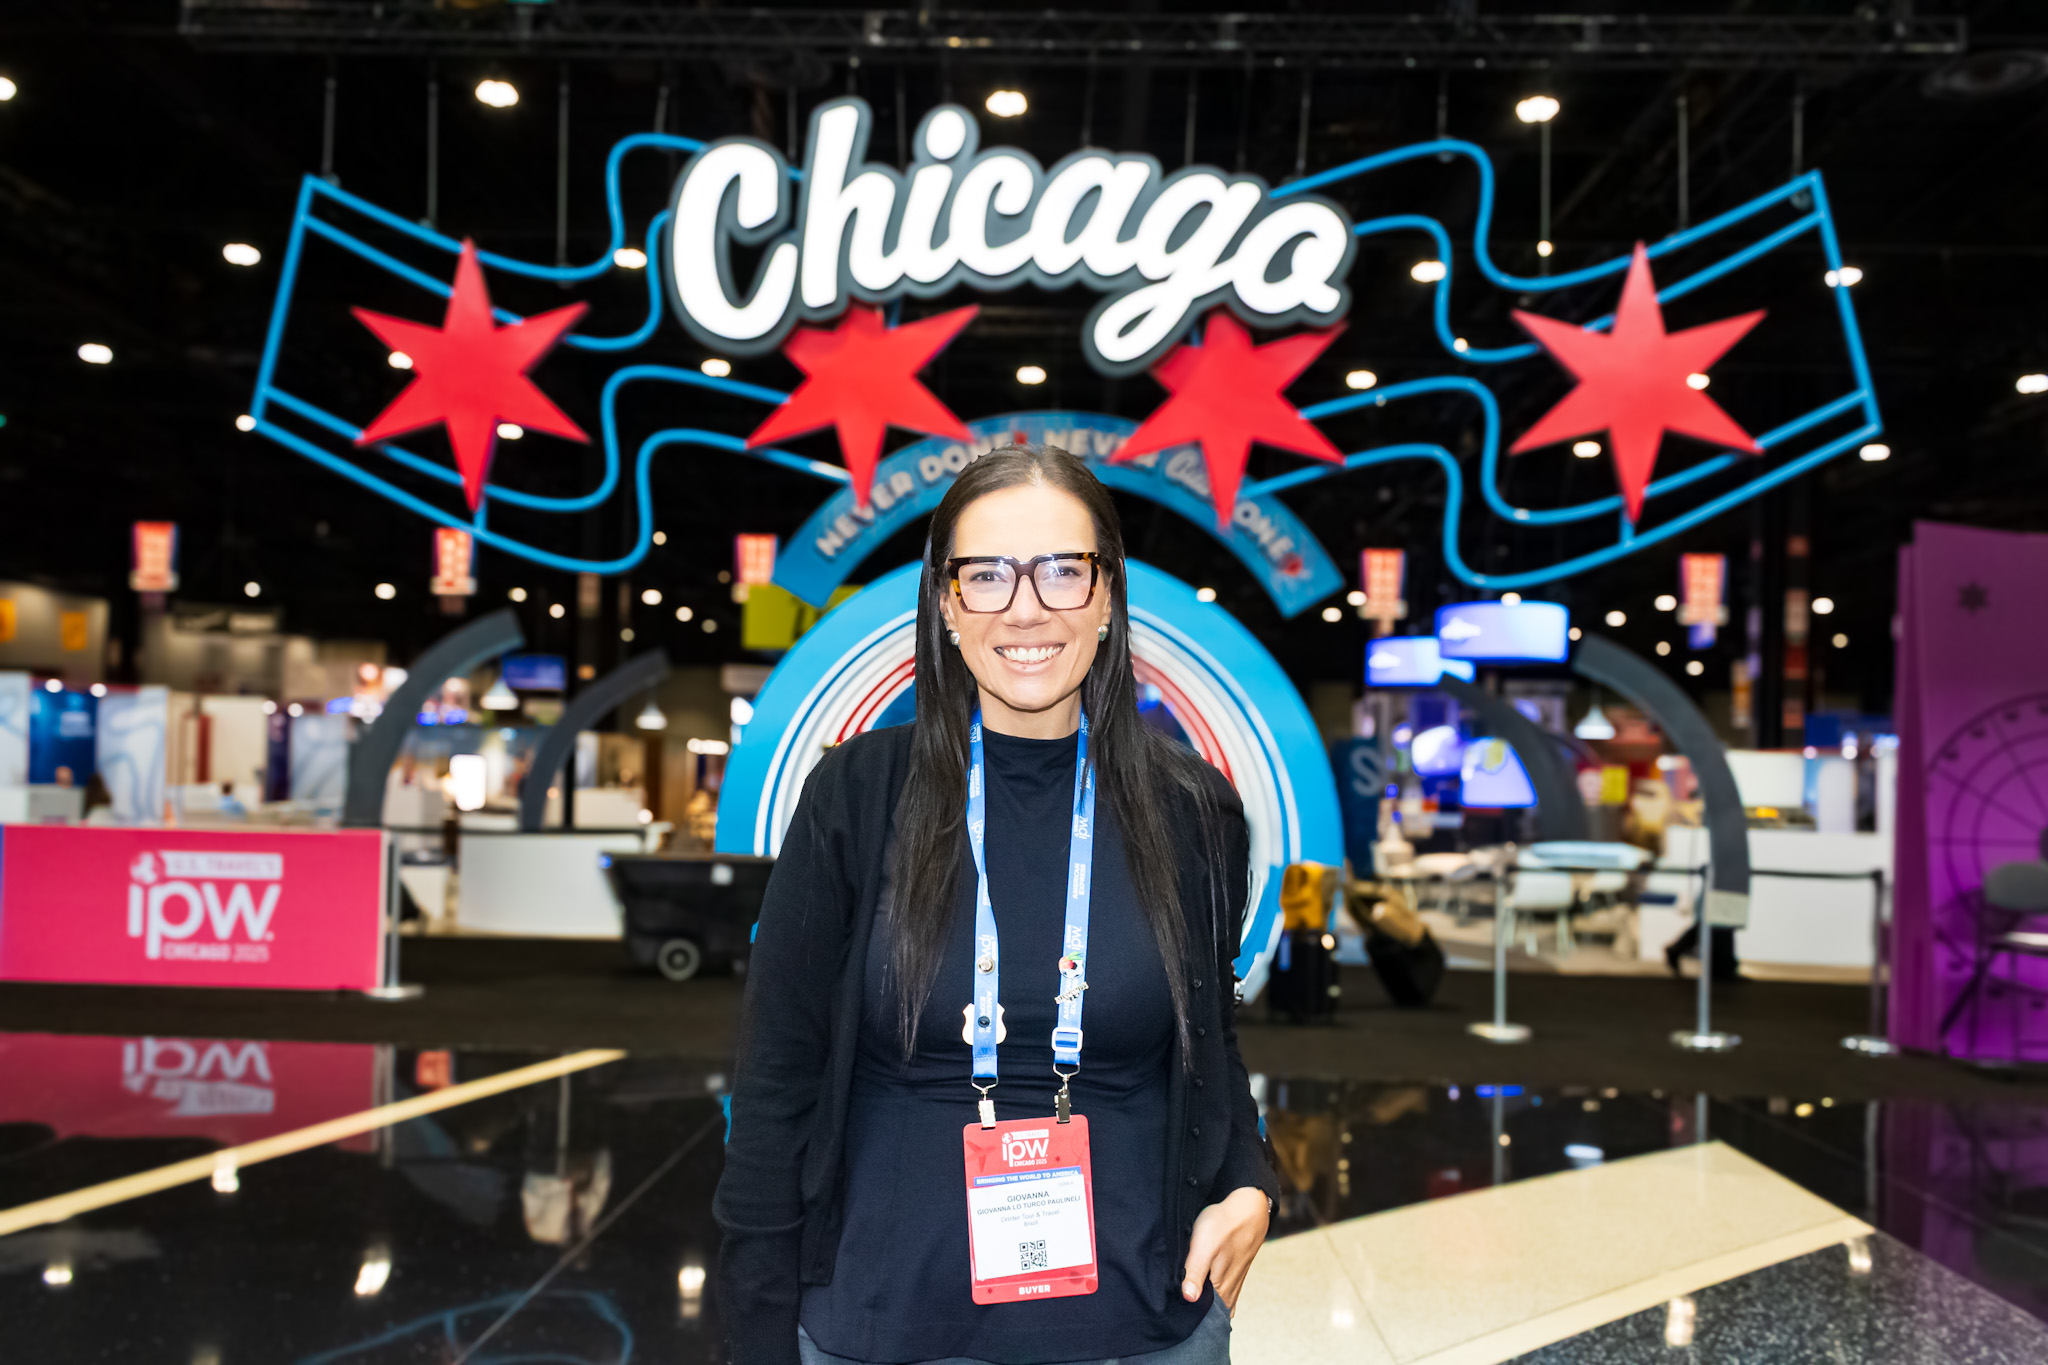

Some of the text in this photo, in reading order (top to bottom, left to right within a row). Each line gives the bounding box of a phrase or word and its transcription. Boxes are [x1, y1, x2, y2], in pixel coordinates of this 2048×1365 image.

[672, 103, 1349, 363] Chicago
[1043, 428, 1159, 468] NEV
[971, 820, 983, 844] ipw
[1079, 816, 1090, 840] ipw
[1072, 863, 1080, 900] AMERICAN
[1078, 863, 1086, 896] EXPRESS
[1071, 926, 1084, 951] ipw
[162, 942, 270, 963] CHICAGO 2025
[985, 991, 993, 1033] AMERIN
[976, 1176, 1005, 1185] BRINGING
[1019, 1172, 1041, 1181] WORLD
[1052, 1169, 1079, 1178] AMERICA
[977, 1205, 1011, 1215] GIOVANNA
[1023, 1200, 1046, 1209] TURCO
[1048, 1195, 1081, 1206] PAULINELI
[1007, 1190, 1050, 1203] GIOVANNA
[1042, 1209, 1060, 1217] Travel
[1018, 1284, 1051, 1295] BUYER
